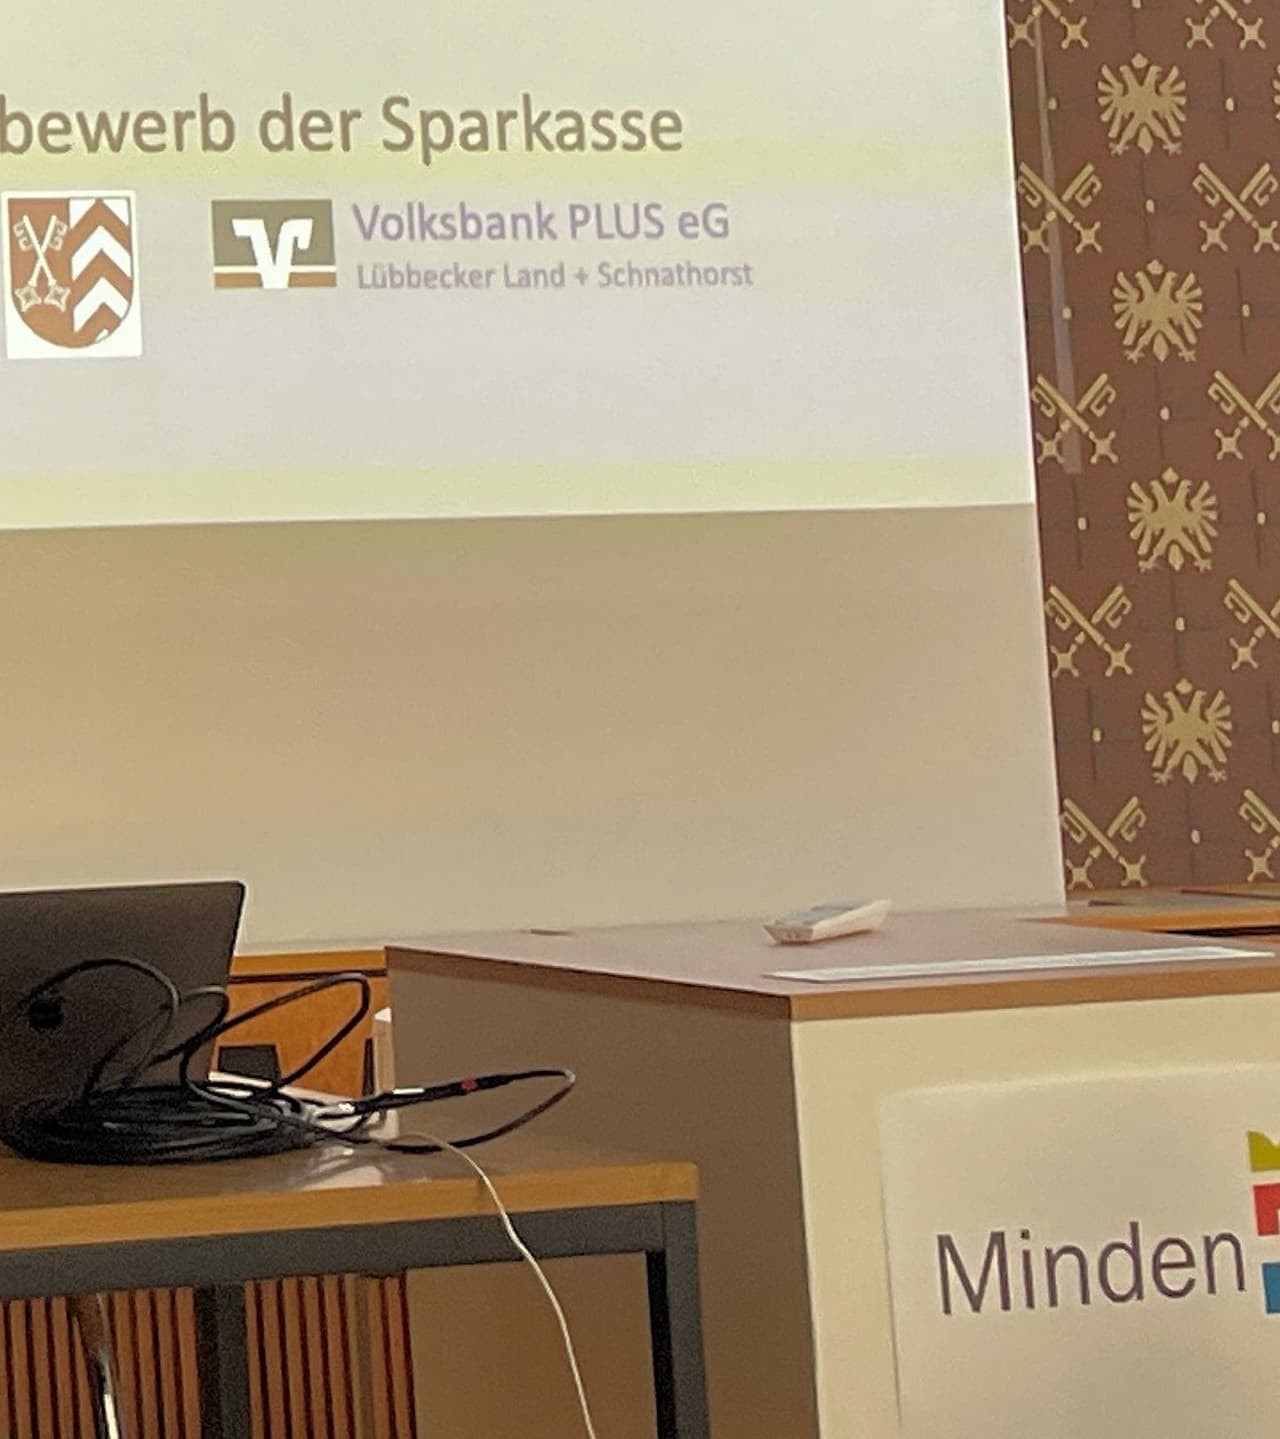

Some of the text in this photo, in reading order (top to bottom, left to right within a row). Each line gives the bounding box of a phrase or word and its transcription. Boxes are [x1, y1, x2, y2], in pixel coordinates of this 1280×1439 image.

[259, 93, 362, 152] der
[382, 93, 682, 165] Sparkasse
[351, 200, 729, 241] Volksbank PLUS eG
[356, 258, 753, 290] Lübbecker Land + Schnathorst
[937, 1222, 1245, 1315] Minden
